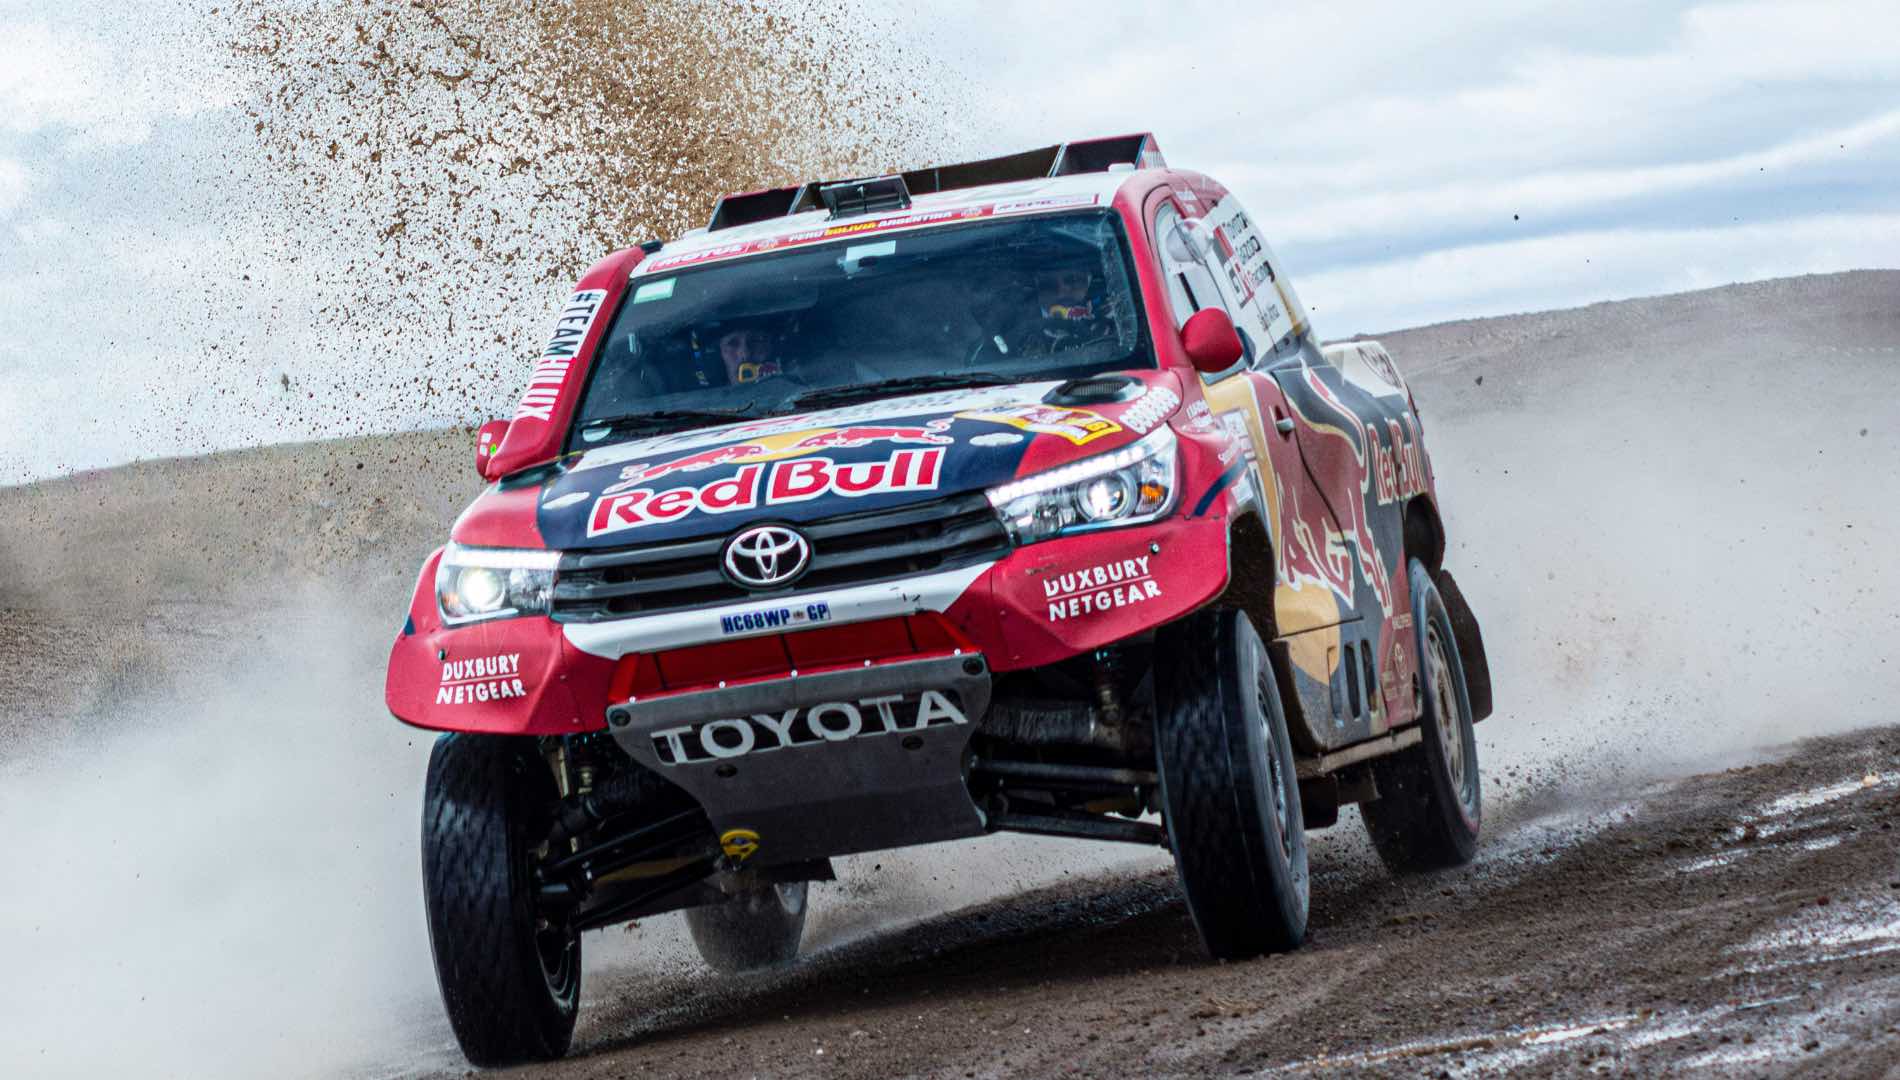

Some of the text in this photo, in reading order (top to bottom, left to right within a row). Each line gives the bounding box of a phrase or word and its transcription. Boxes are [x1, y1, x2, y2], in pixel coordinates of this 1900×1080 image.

[588, 447, 945, 536] Red Bull
[1043, 555, 1149, 597] DUXBURY
[807, 603, 827, 621] GP
[1048, 579, 1162, 621] NETGEAR
[441, 653, 520, 681] DUXBURY
[436, 678, 527, 704] NETGEAR
[651, 690, 968, 765] TOYOTA
